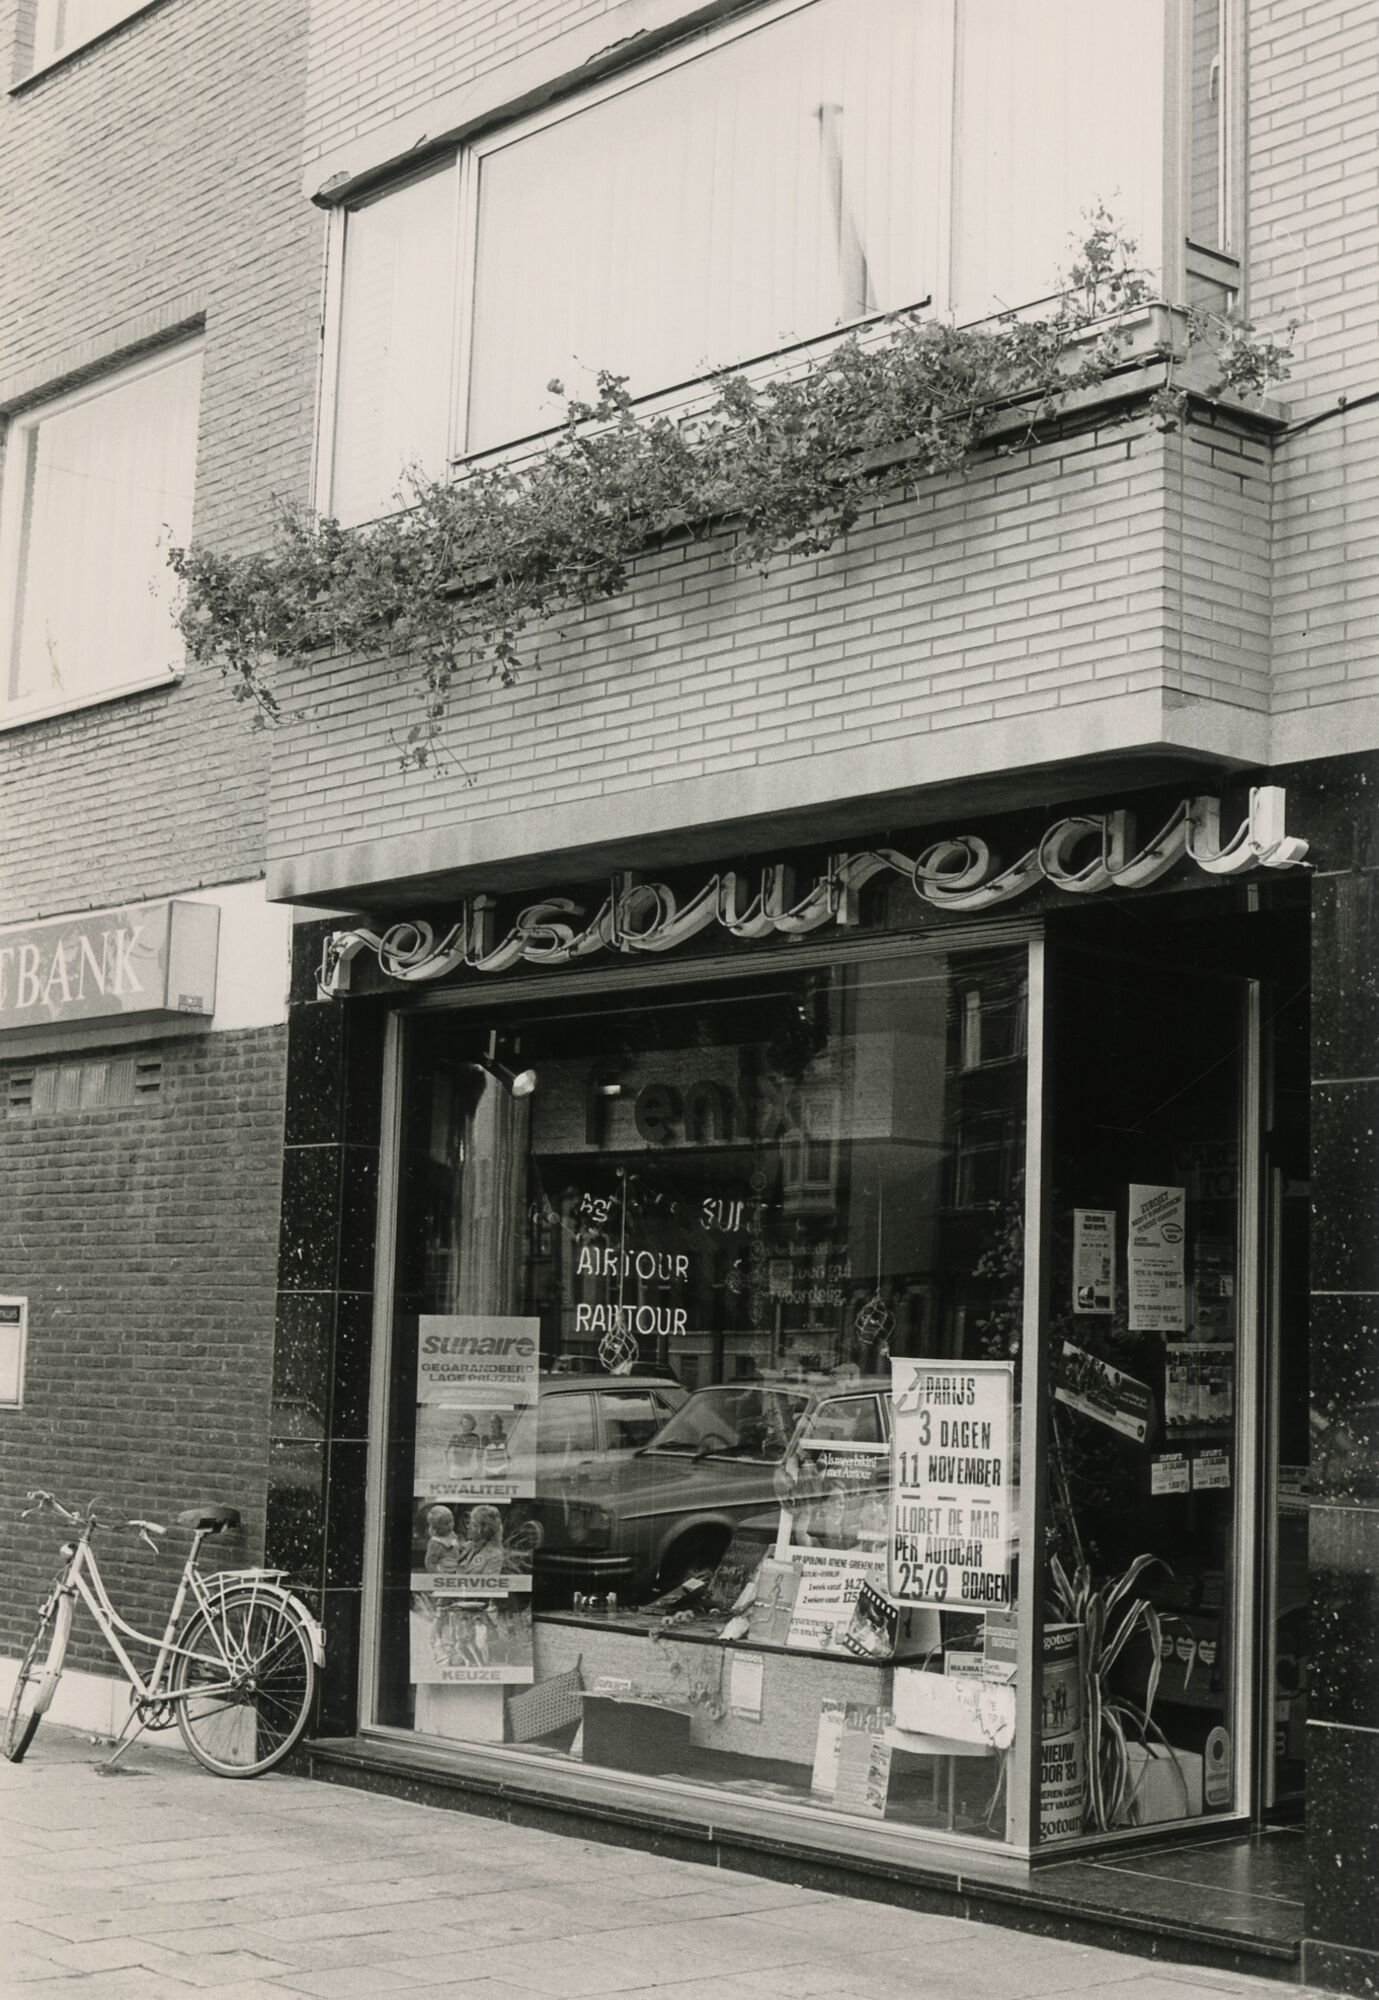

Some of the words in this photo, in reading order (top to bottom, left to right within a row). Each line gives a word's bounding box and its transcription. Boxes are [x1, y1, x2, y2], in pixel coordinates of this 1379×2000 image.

[576, 1246, 689, 1282] AIRTOUR
[421, 1362, 535, 1374] GEGARANDEERD
[429, 1373, 466, 1382] LAGE
[468, 1374, 527, 1384] PRIJZEN
[926, 1376, 976, 1406] PARIJS
[918, 1409, 932, 1447] 3
[940, 1420, 992, 1450] DAGEN
[898, 1451, 921, 1489] 11
[928, 1454, 1002, 1488] NOVEMBER
[429, 1483, 520, 1495] KWALITEIT
[895, 1504, 943, 1536] LLORET
[948, 1507, 964, 1537] DE
[970, 1509, 1000, 1540] MAR
[894, 1533, 920, 1563] PER
[924, 1536, 983, 1568] AUTOCAR
[433, 1577, 510, 1589] SERVICE
[898, 1562, 949, 1603] 25/9
[441, 1670, 501, 1681] KEUZE
[1041, 1743, 1075, 1764] NIEUW
[1040, 1763, 1063, 1784] OOR
[1040, 1789, 1062, 1800] EREN
